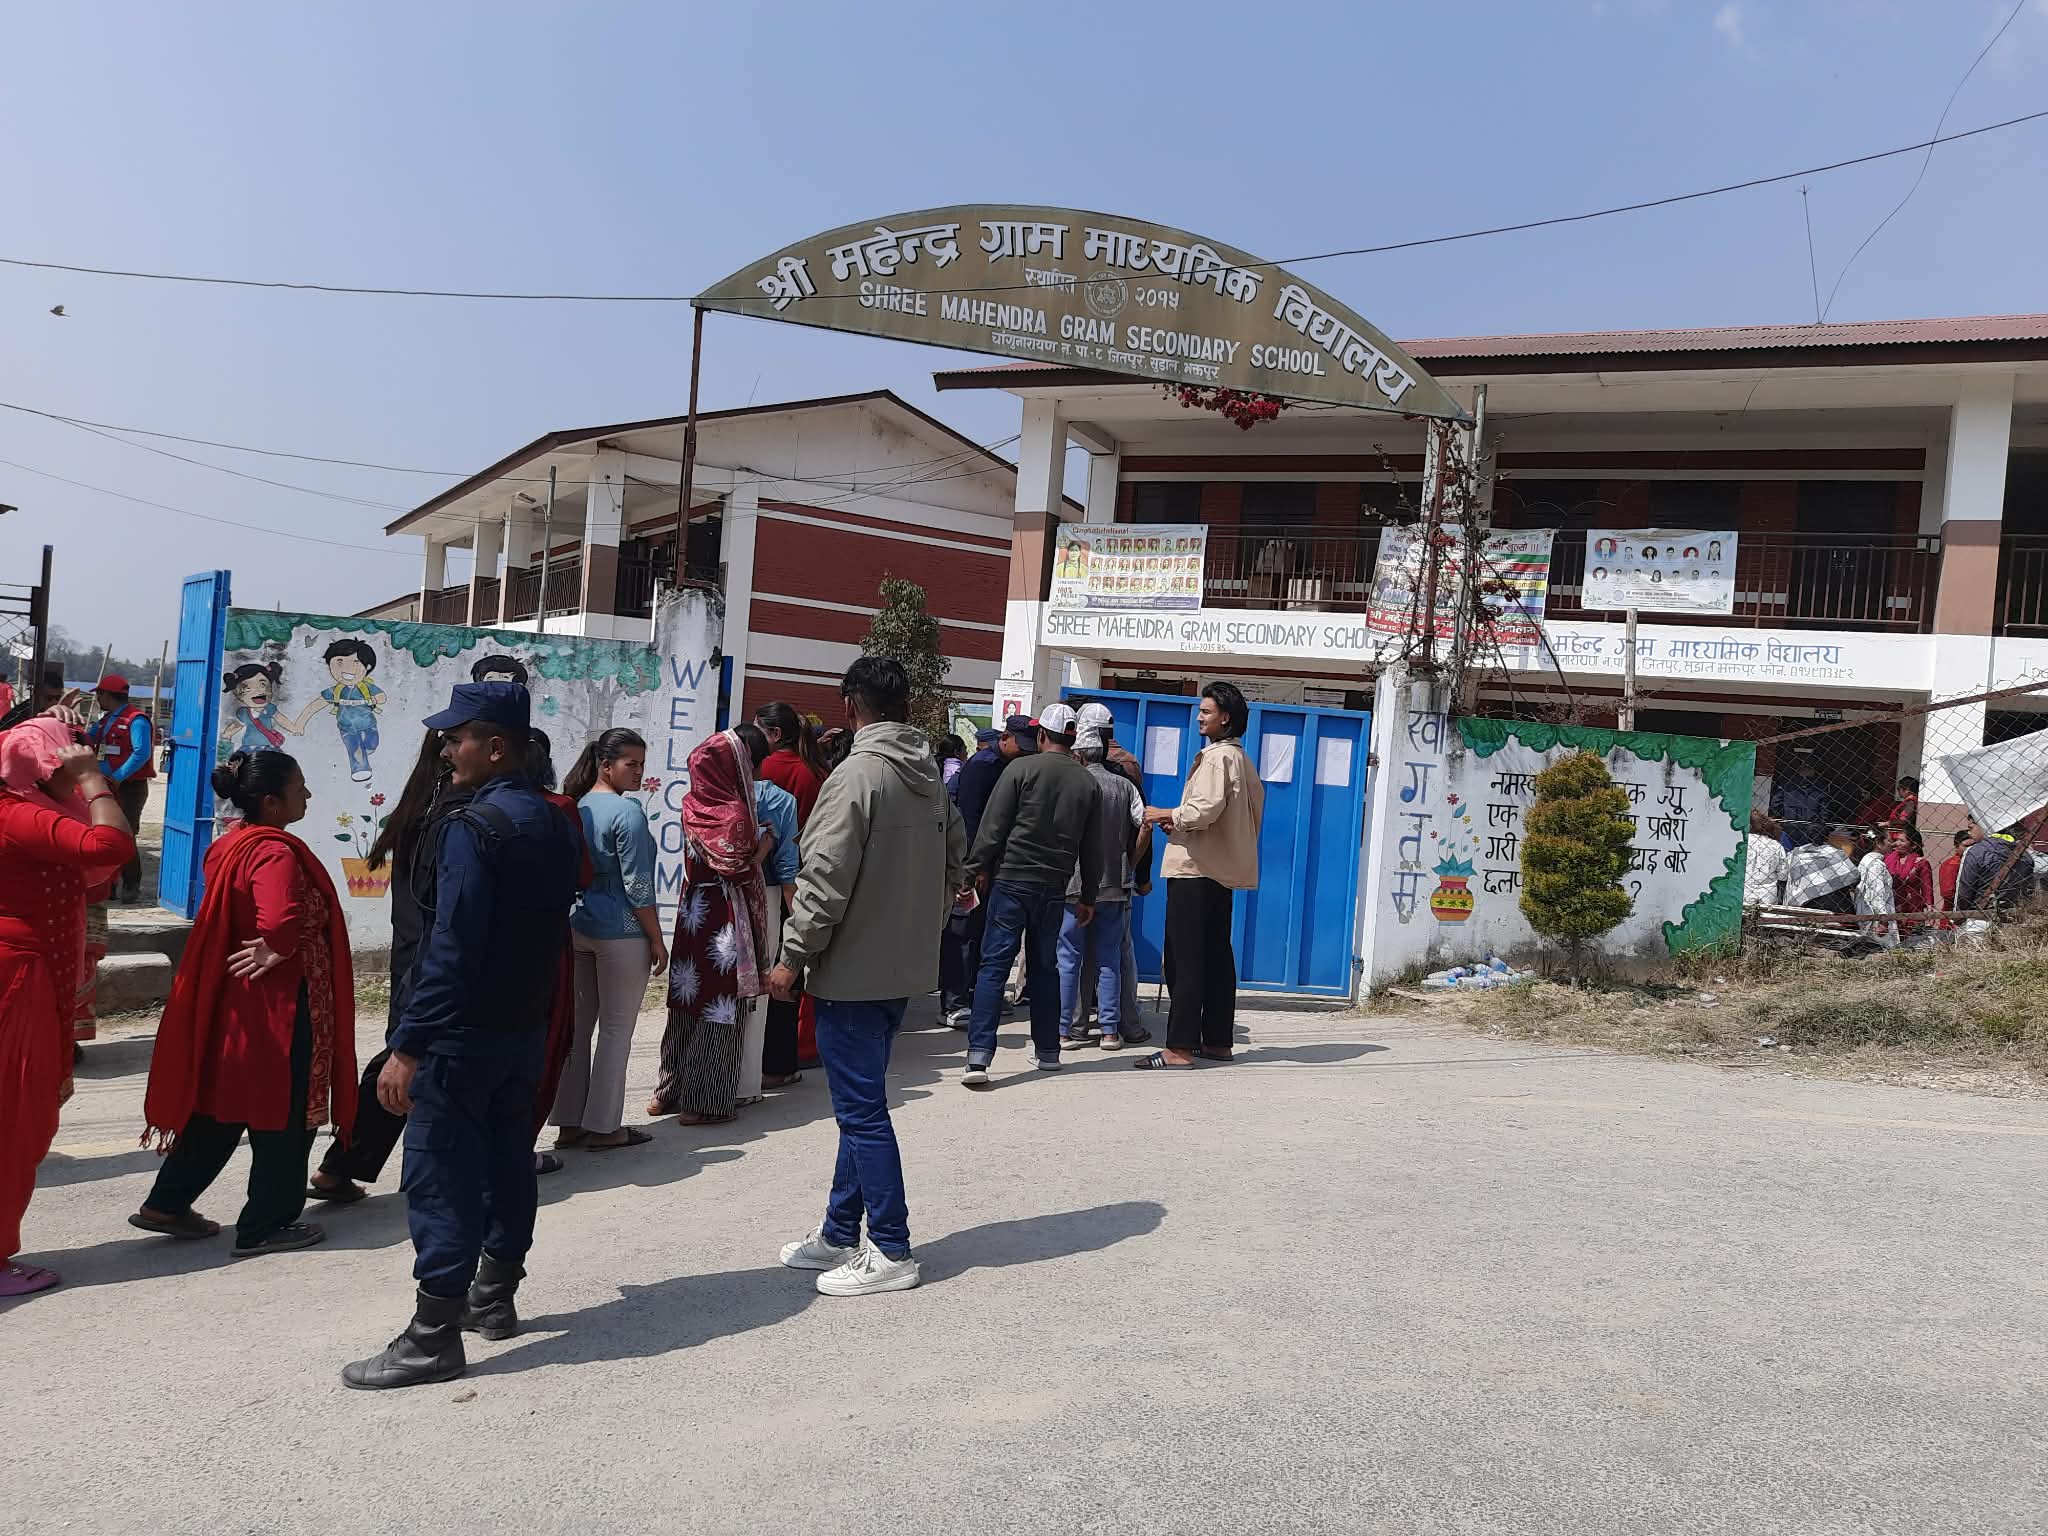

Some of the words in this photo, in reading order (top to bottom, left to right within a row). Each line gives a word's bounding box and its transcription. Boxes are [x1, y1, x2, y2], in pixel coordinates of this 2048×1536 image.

[1025, 267, 1077, 296] स्थापित
[756, 256, 817, 311] श्री
[826, 226, 961, 281] महेन्द्र
[979, 221, 1069, 263] ग्राम
[1084, 226, 1264, 304] माध्यमिक
[1273, 284, 1416, 405] विद्यालय
[859, 281, 928, 317] SHREE
[940, 295, 1047, 335] MAHENDRA
[1060, 314, 1115, 346] GRAM
[1126, 325, 1241, 364] SECONDARY
[1250, 343, 1327, 377] SCHOOL
[1047, 614, 1091, 636] SHREE
[1098, 617, 1174, 641] MAHENDRA
[1180, 620, 1221, 643] GRAM
[1226, 622, 1317, 647] SECONDARY
[1551, 631, 1606, 654] महेन्द्र
[1668, 635, 1762, 661] माध्यमिक
[1767, 636, 1845, 665] विद्यालय
[1486, 803, 1519, 828] एक
